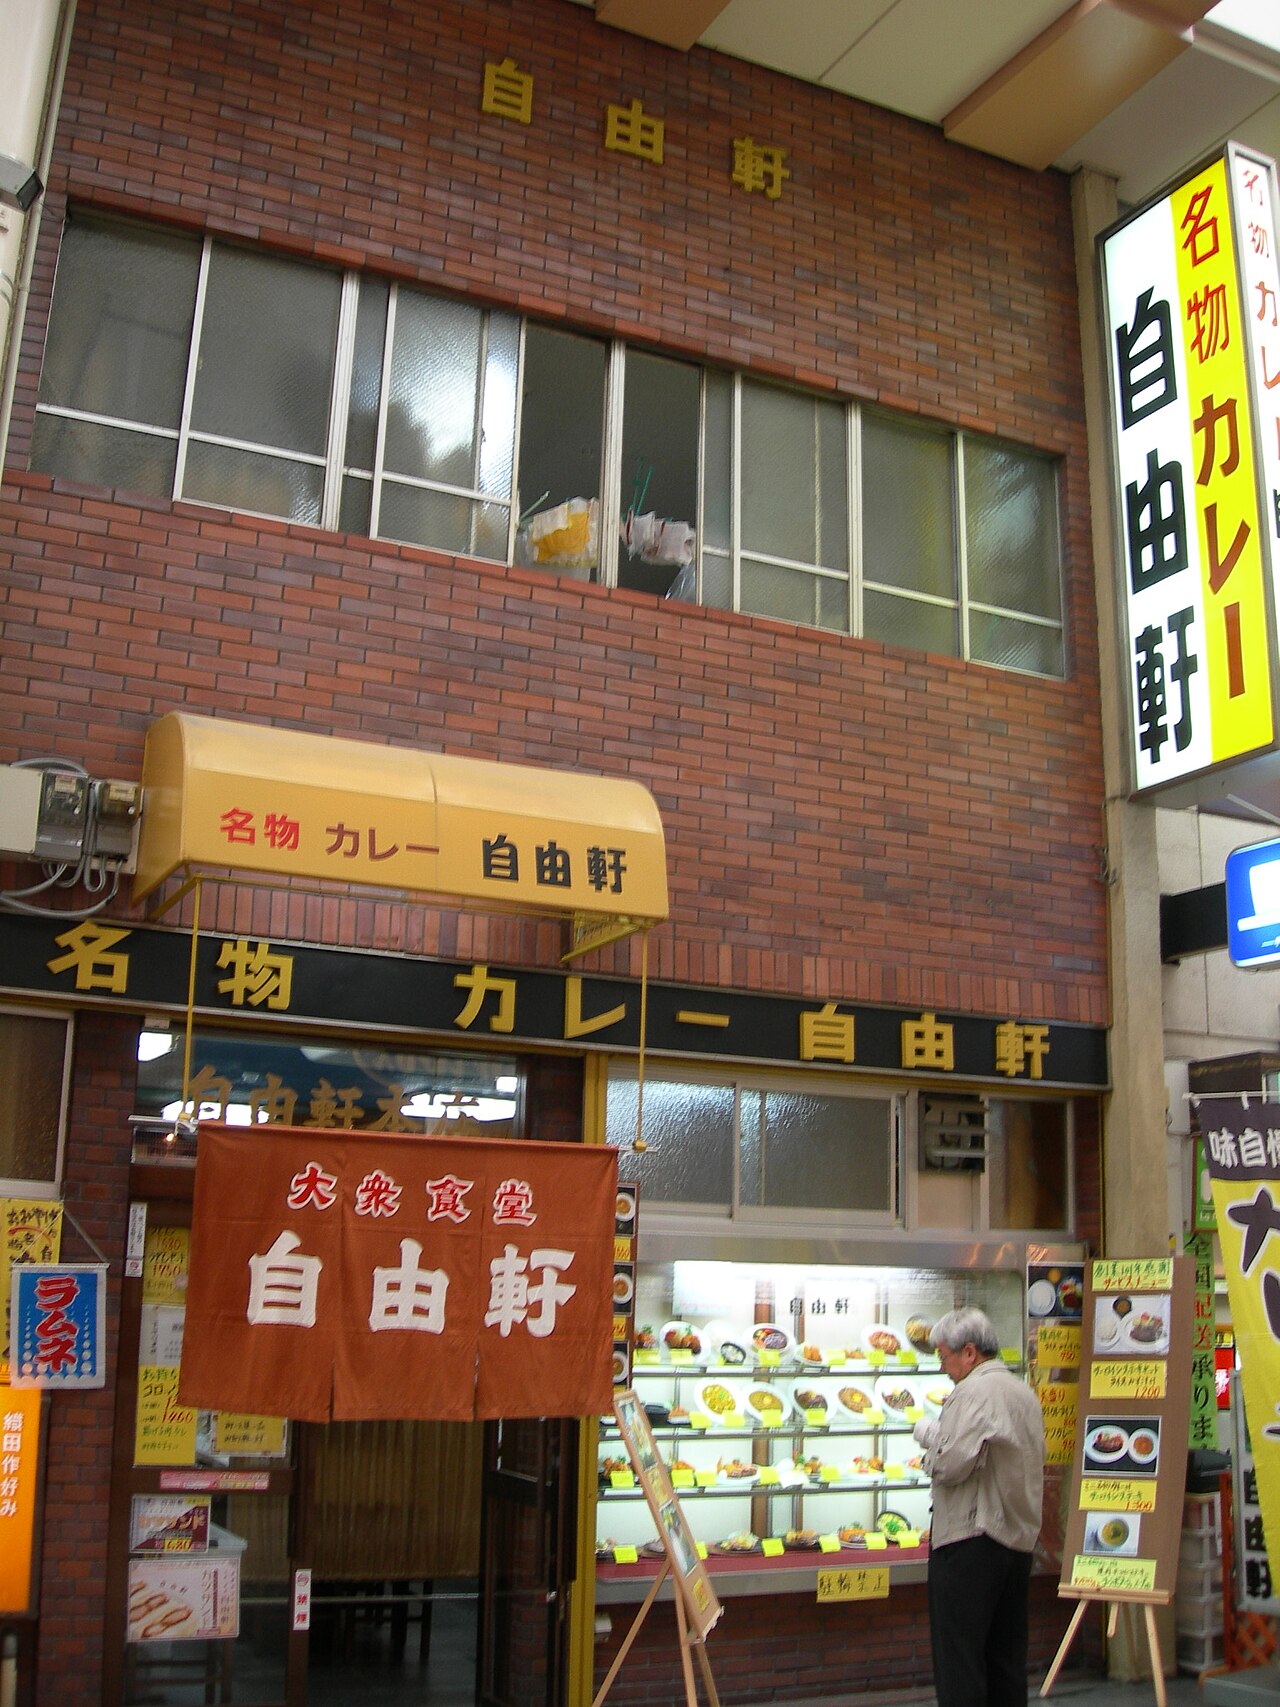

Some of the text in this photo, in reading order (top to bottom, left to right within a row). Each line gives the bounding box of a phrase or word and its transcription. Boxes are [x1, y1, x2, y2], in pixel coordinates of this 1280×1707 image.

[482, 57, 790, 199] 自由軒
[1180, 185, 1251, 699] 名物カレー
[1116, 286, 1198, 764] 自由軒
[220, 807, 627, 893] 名物 カレー 自由軒
[799, 1002, 1050, 1080] 自由軒
[287, 1161, 538, 1227] 大衆食堂
[34, 1274, 81, 1373] ラムネ
[246, 1230, 577, 1338] 自由軒
[1183, 1233, 1217, 1450] 全国配送承りま
[0, 1411, 24, 1517] 織田作好み
